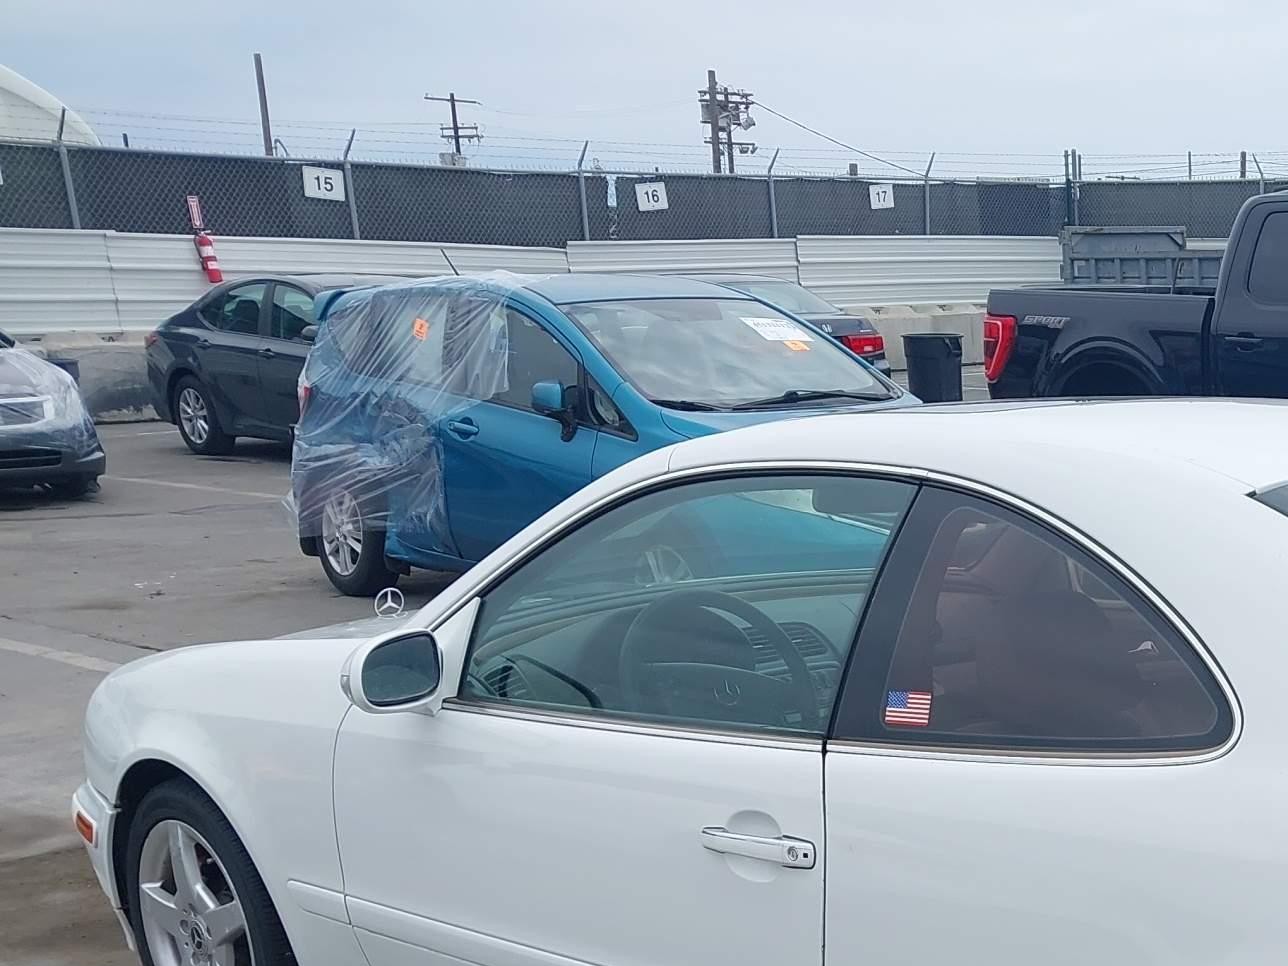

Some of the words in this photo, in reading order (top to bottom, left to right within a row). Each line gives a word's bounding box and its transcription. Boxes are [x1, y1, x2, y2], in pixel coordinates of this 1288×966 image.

[314, 175, 334, 192] 15
[644, 189, 660, 204] 16
[875, 190, 887, 203] 17
